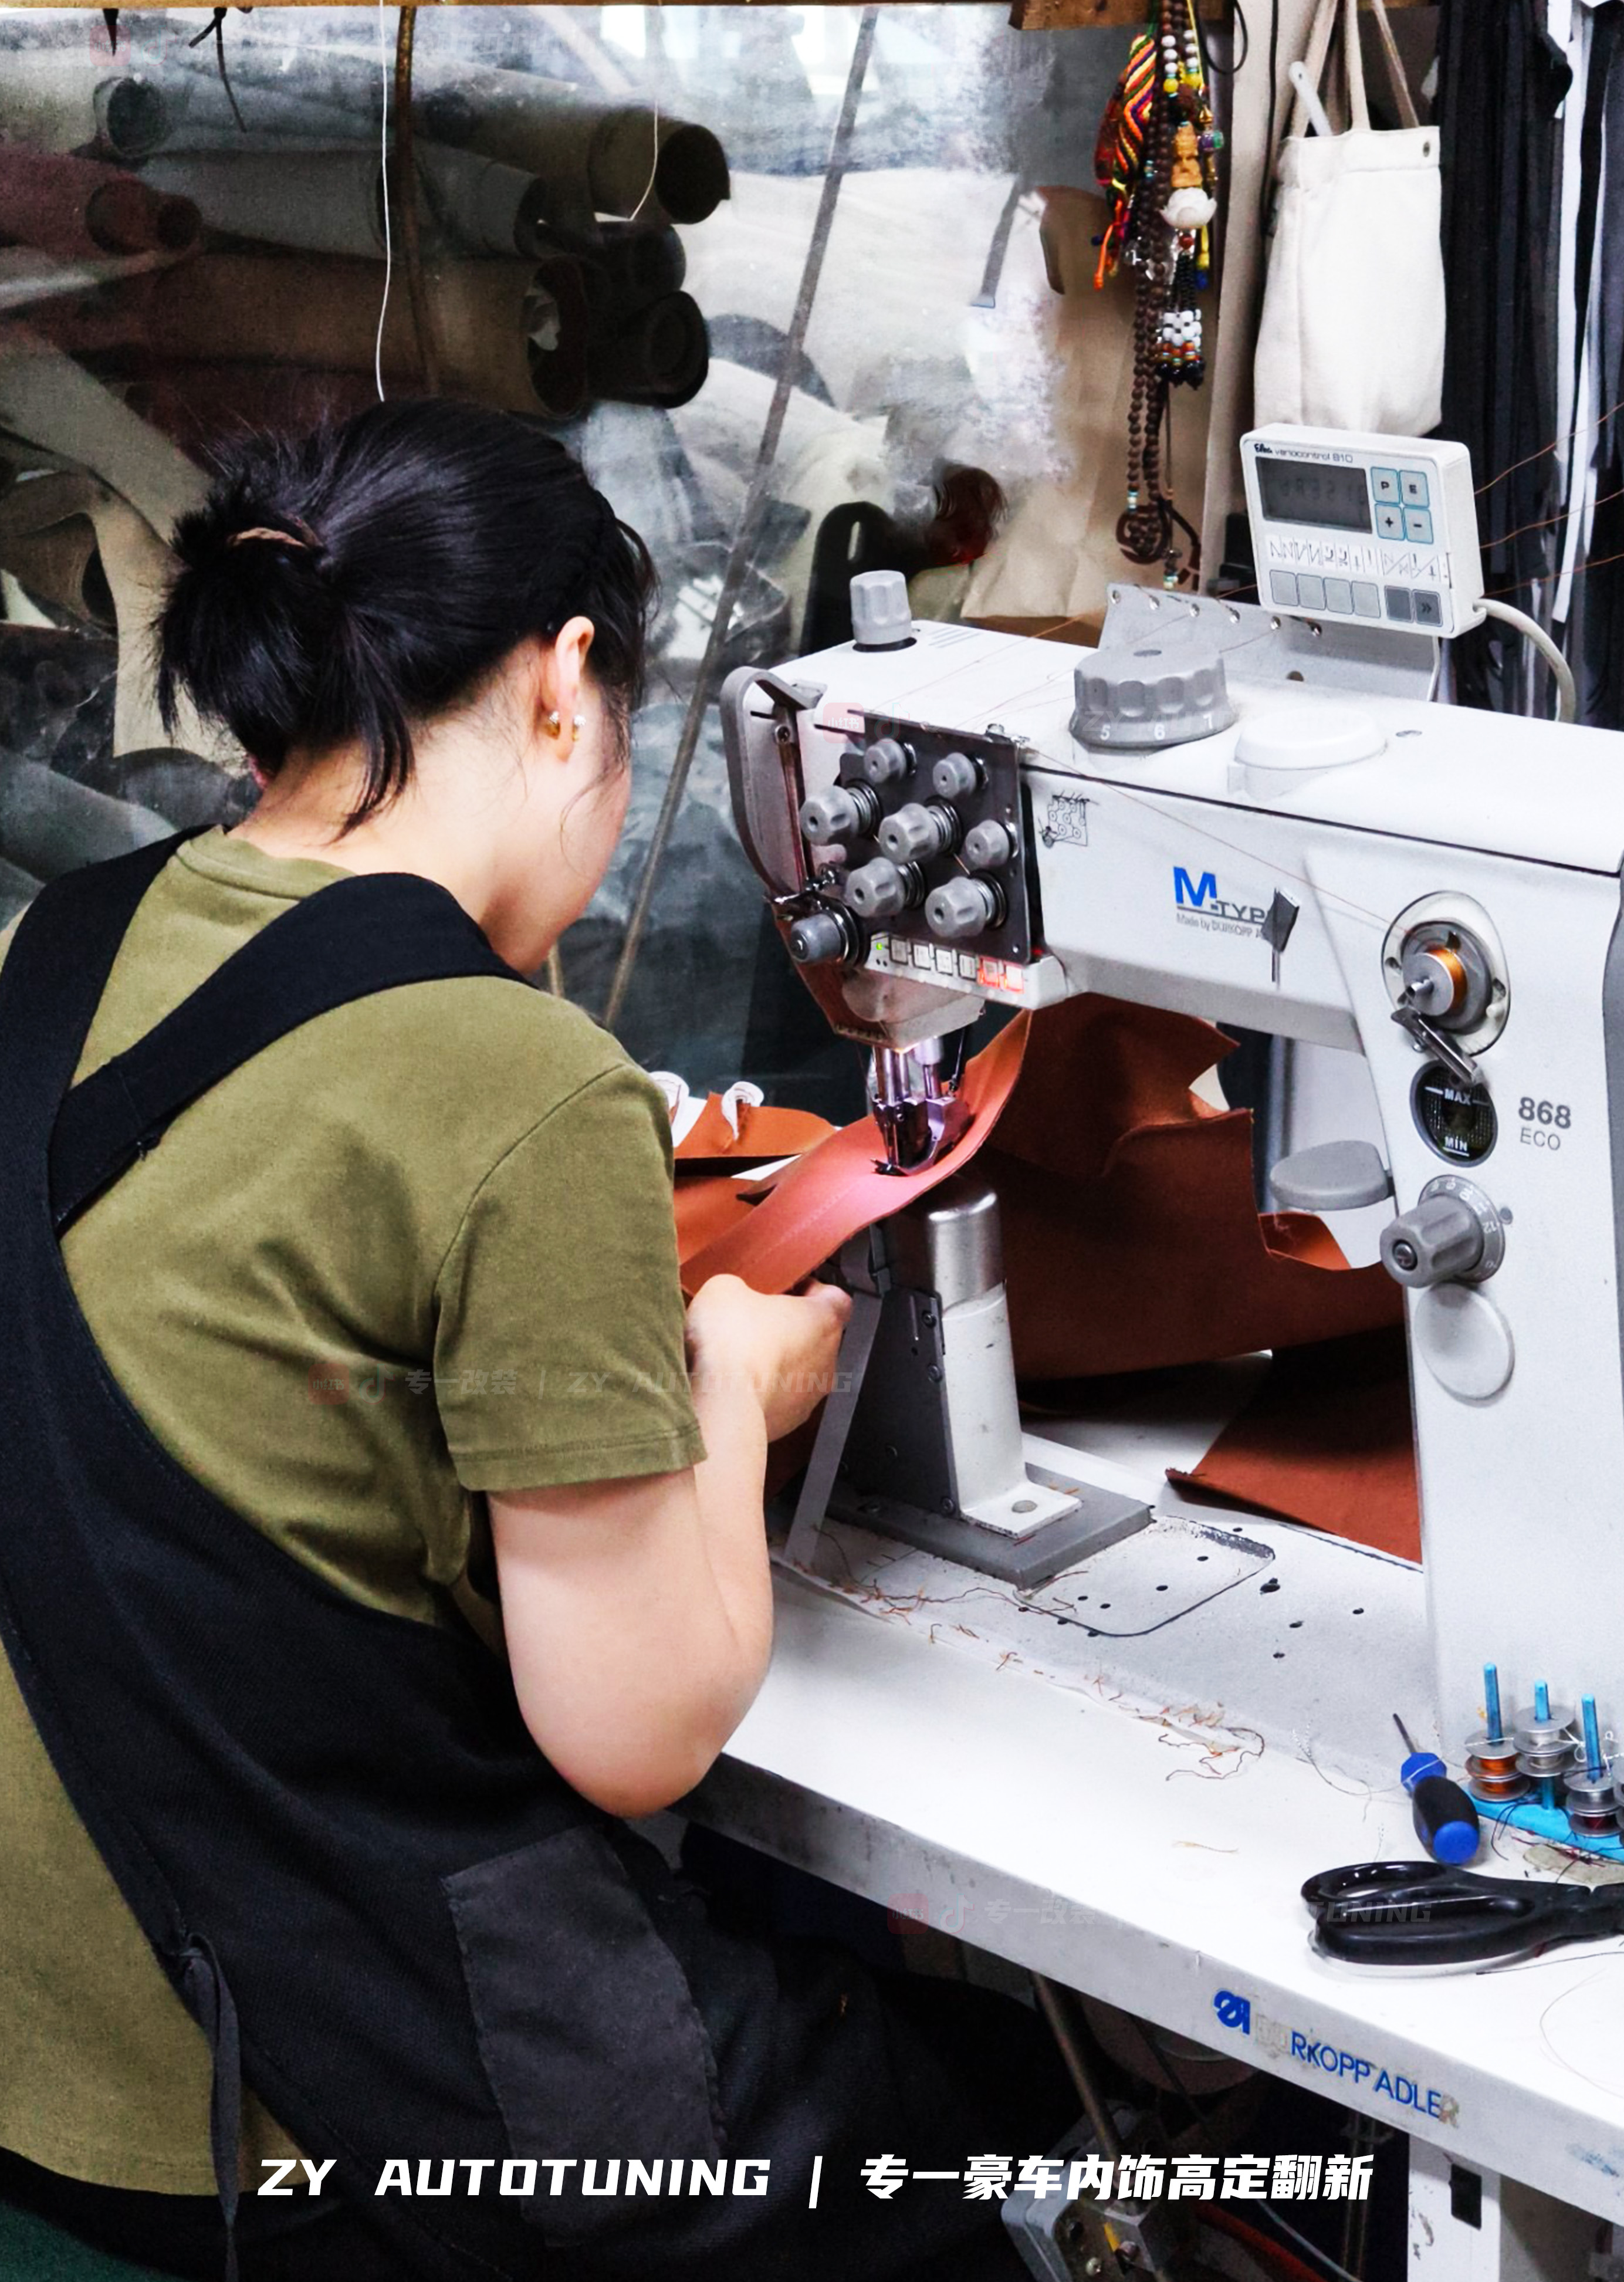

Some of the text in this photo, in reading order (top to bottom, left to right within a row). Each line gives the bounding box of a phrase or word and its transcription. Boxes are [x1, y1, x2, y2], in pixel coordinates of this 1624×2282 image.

[1381, 481, 1390, 491] P
[1100, 714, 1213, 741] 5 6 7
[1173, 866, 1266, 924] M-TYP
[1201, 919, 1210, 931] by
[1444, 1088, 1471, 1105] MAX
[1518, 1097, 1571, 1129] 868
[1520, 1128, 1561, 1151] ECO
